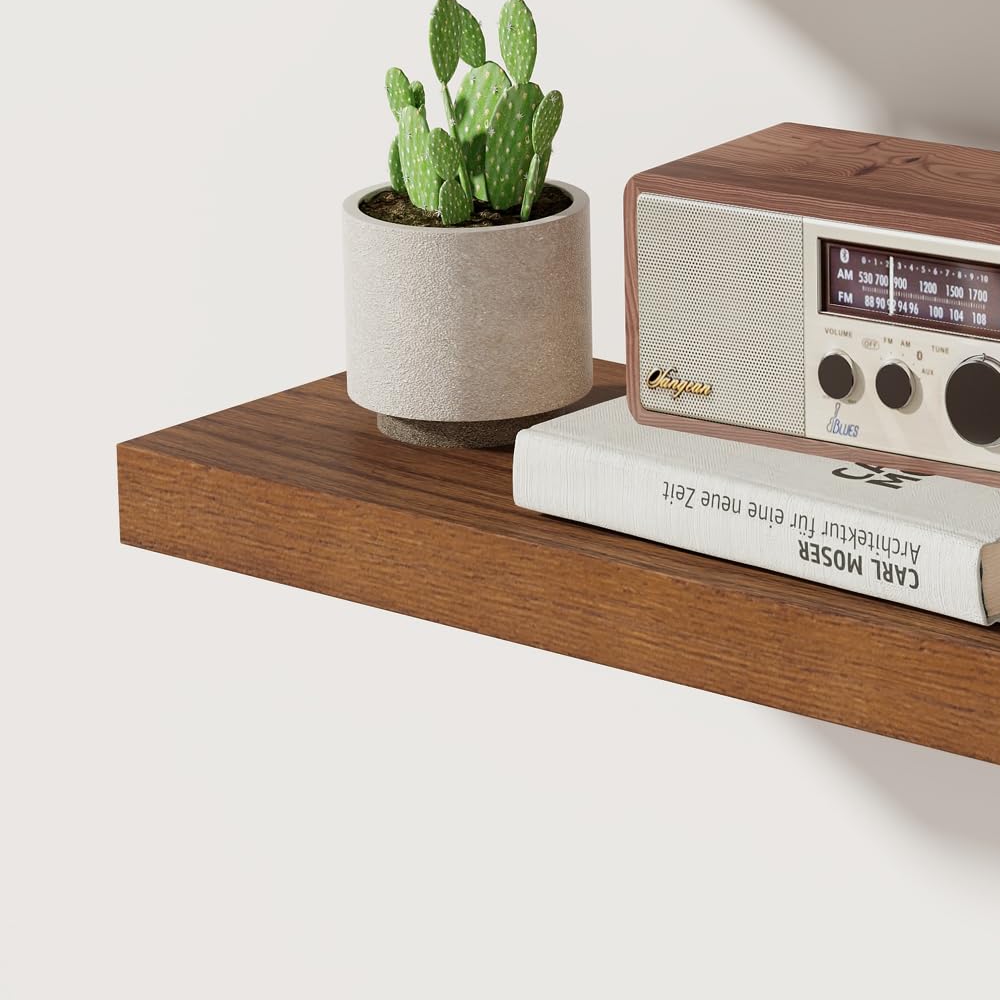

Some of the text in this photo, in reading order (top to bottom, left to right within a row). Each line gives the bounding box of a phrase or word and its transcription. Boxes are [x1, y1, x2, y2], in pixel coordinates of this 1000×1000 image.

[837, 268, 988, 302] AM 530 700 900 1200 1500 1700
[838, 291, 853, 304] FM
[864, 295, 874, 307] 88
[875, 297, 885, 310] 90
[898, 301, 907, 313] 94
[909, 302, 919, 315] 96
[929, 305, 943, 319] 100
[949, 308, 964, 322] 104
[972, 312, 987, 325] 108
[824, 327, 852, 338] VOLUME
[883, 337, 911, 348] FM AM
[931, 345, 949, 354] TUNE
[663, 481, 921, 565] Architektur für eine neue Zeit
[798, 540, 920, 590] CARL MOSER
